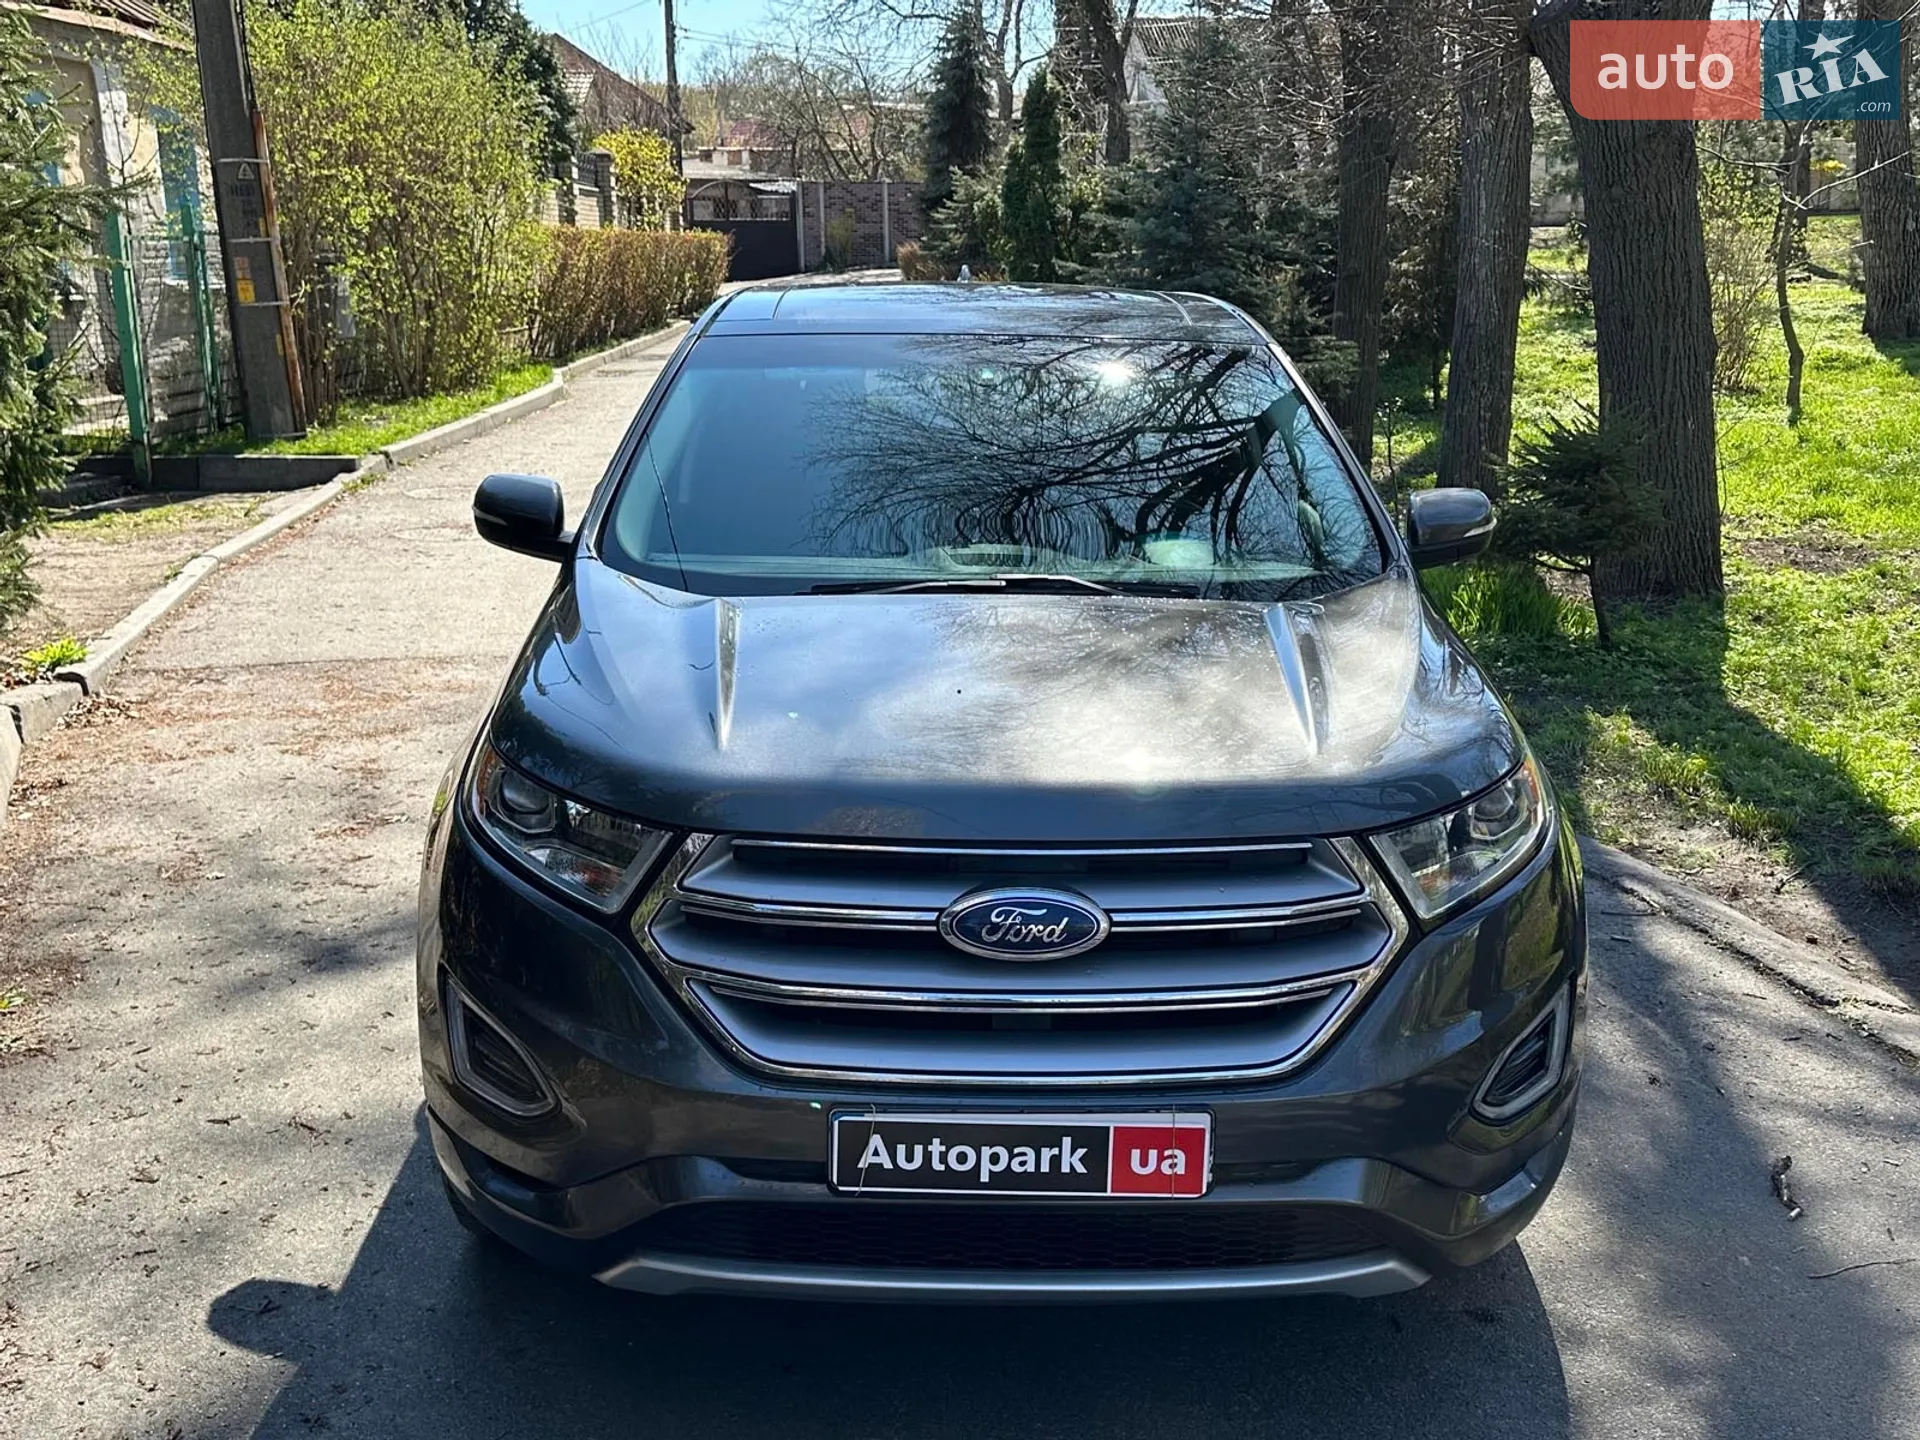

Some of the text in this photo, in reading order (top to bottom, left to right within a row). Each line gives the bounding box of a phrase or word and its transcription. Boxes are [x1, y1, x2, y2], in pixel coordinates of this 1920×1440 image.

[981, 906, 1070, 942] Ford
[857, 1133, 1186, 1182] Autopark ua
